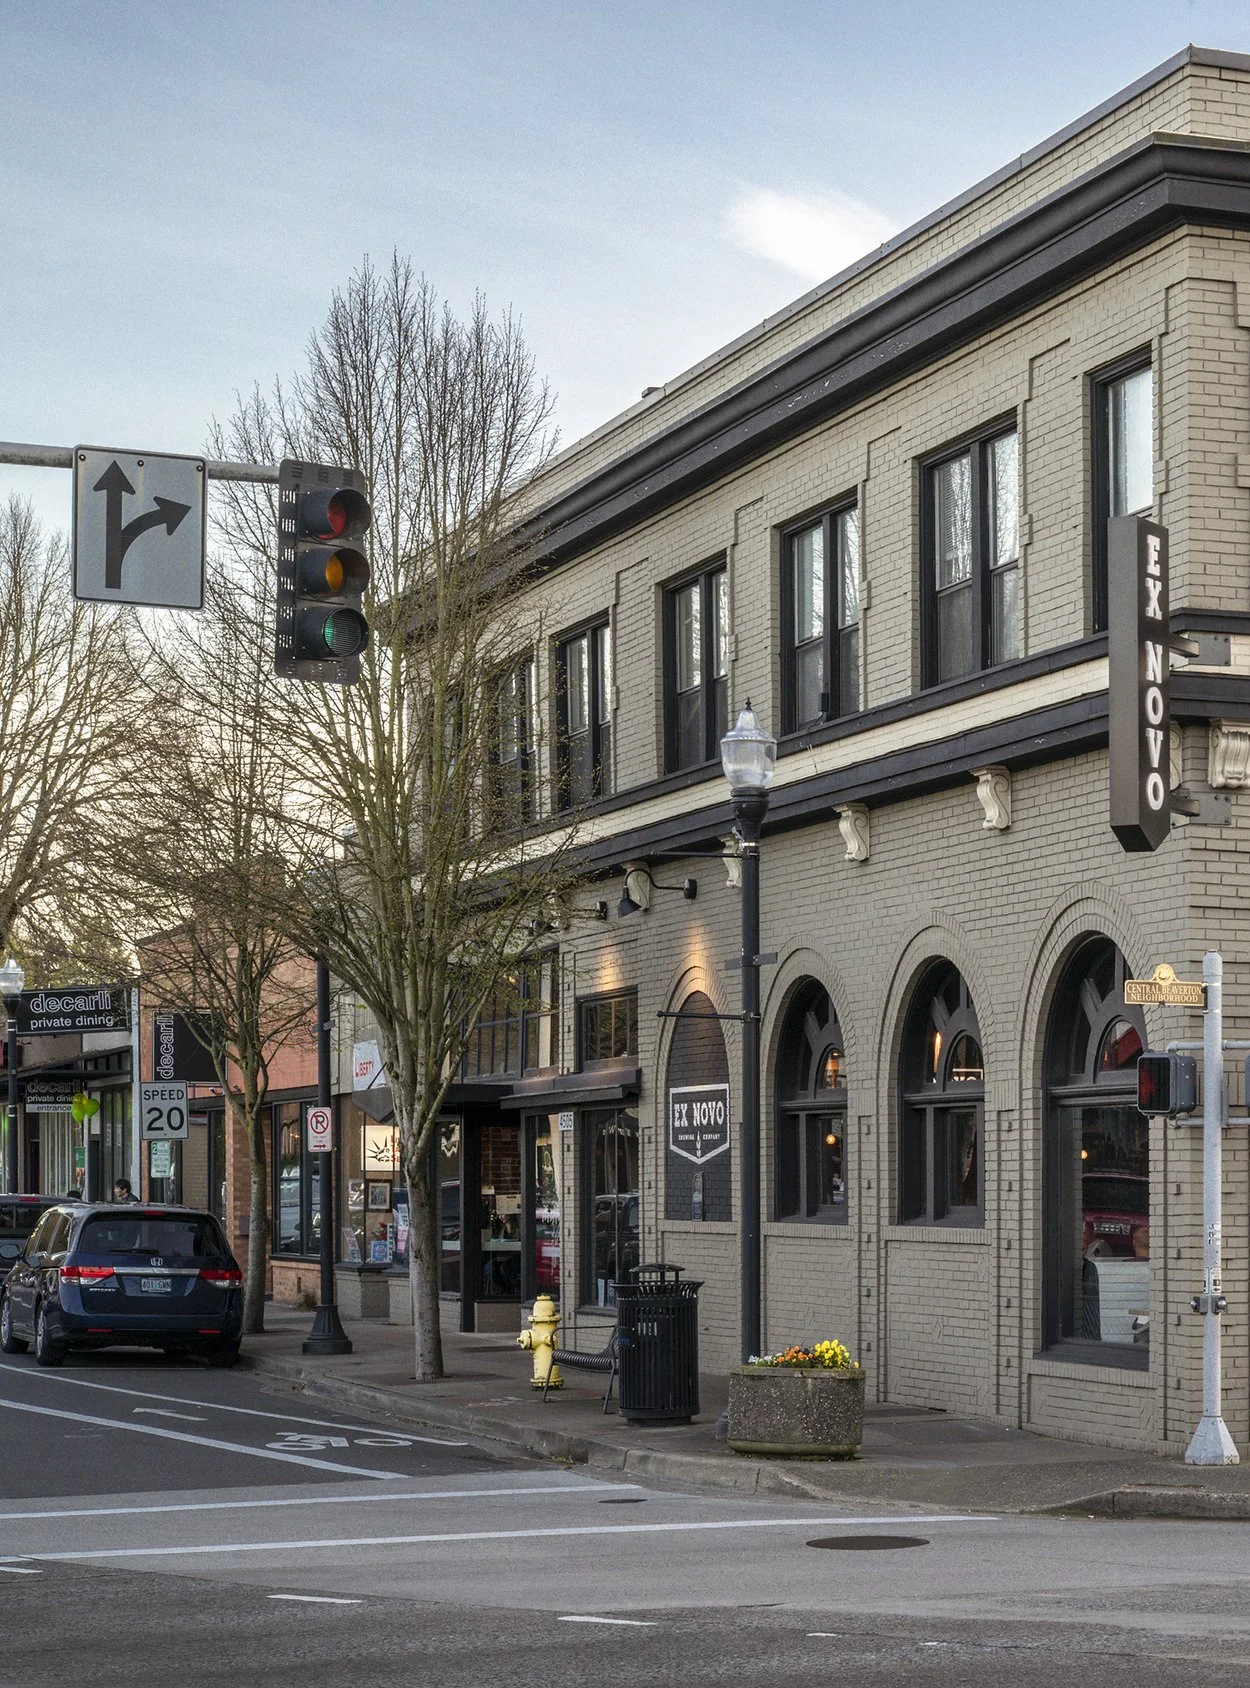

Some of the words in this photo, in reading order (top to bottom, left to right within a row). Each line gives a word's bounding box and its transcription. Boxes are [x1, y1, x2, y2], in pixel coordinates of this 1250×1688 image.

[1145, 534, 1163, 620] EX
[1145, 640, 1165, 811] NOVO
[1126, 983, 1161, 994] CENTRAL
[1162, 984, 1201, 995] BEAVERTON
[29, 990, 112, 1014] decarli
[1131, 993, 1199, 1003] NEIGHBORHOOD
[30, 1016, 72, 1031] private
[75, 1014, 115, 1028] dining
[27, 1079, 82, 1093] decarli
[27, 1095, 56, 1104] private
[143, 1089, 185, 1100] SPEED
[36, 1103, 72, 1113] entrance
[673, 1103, 688, 1127] EX
[693, 1101, 724, 1126] NOVO
[146, 1106, 185, 1131] 20
